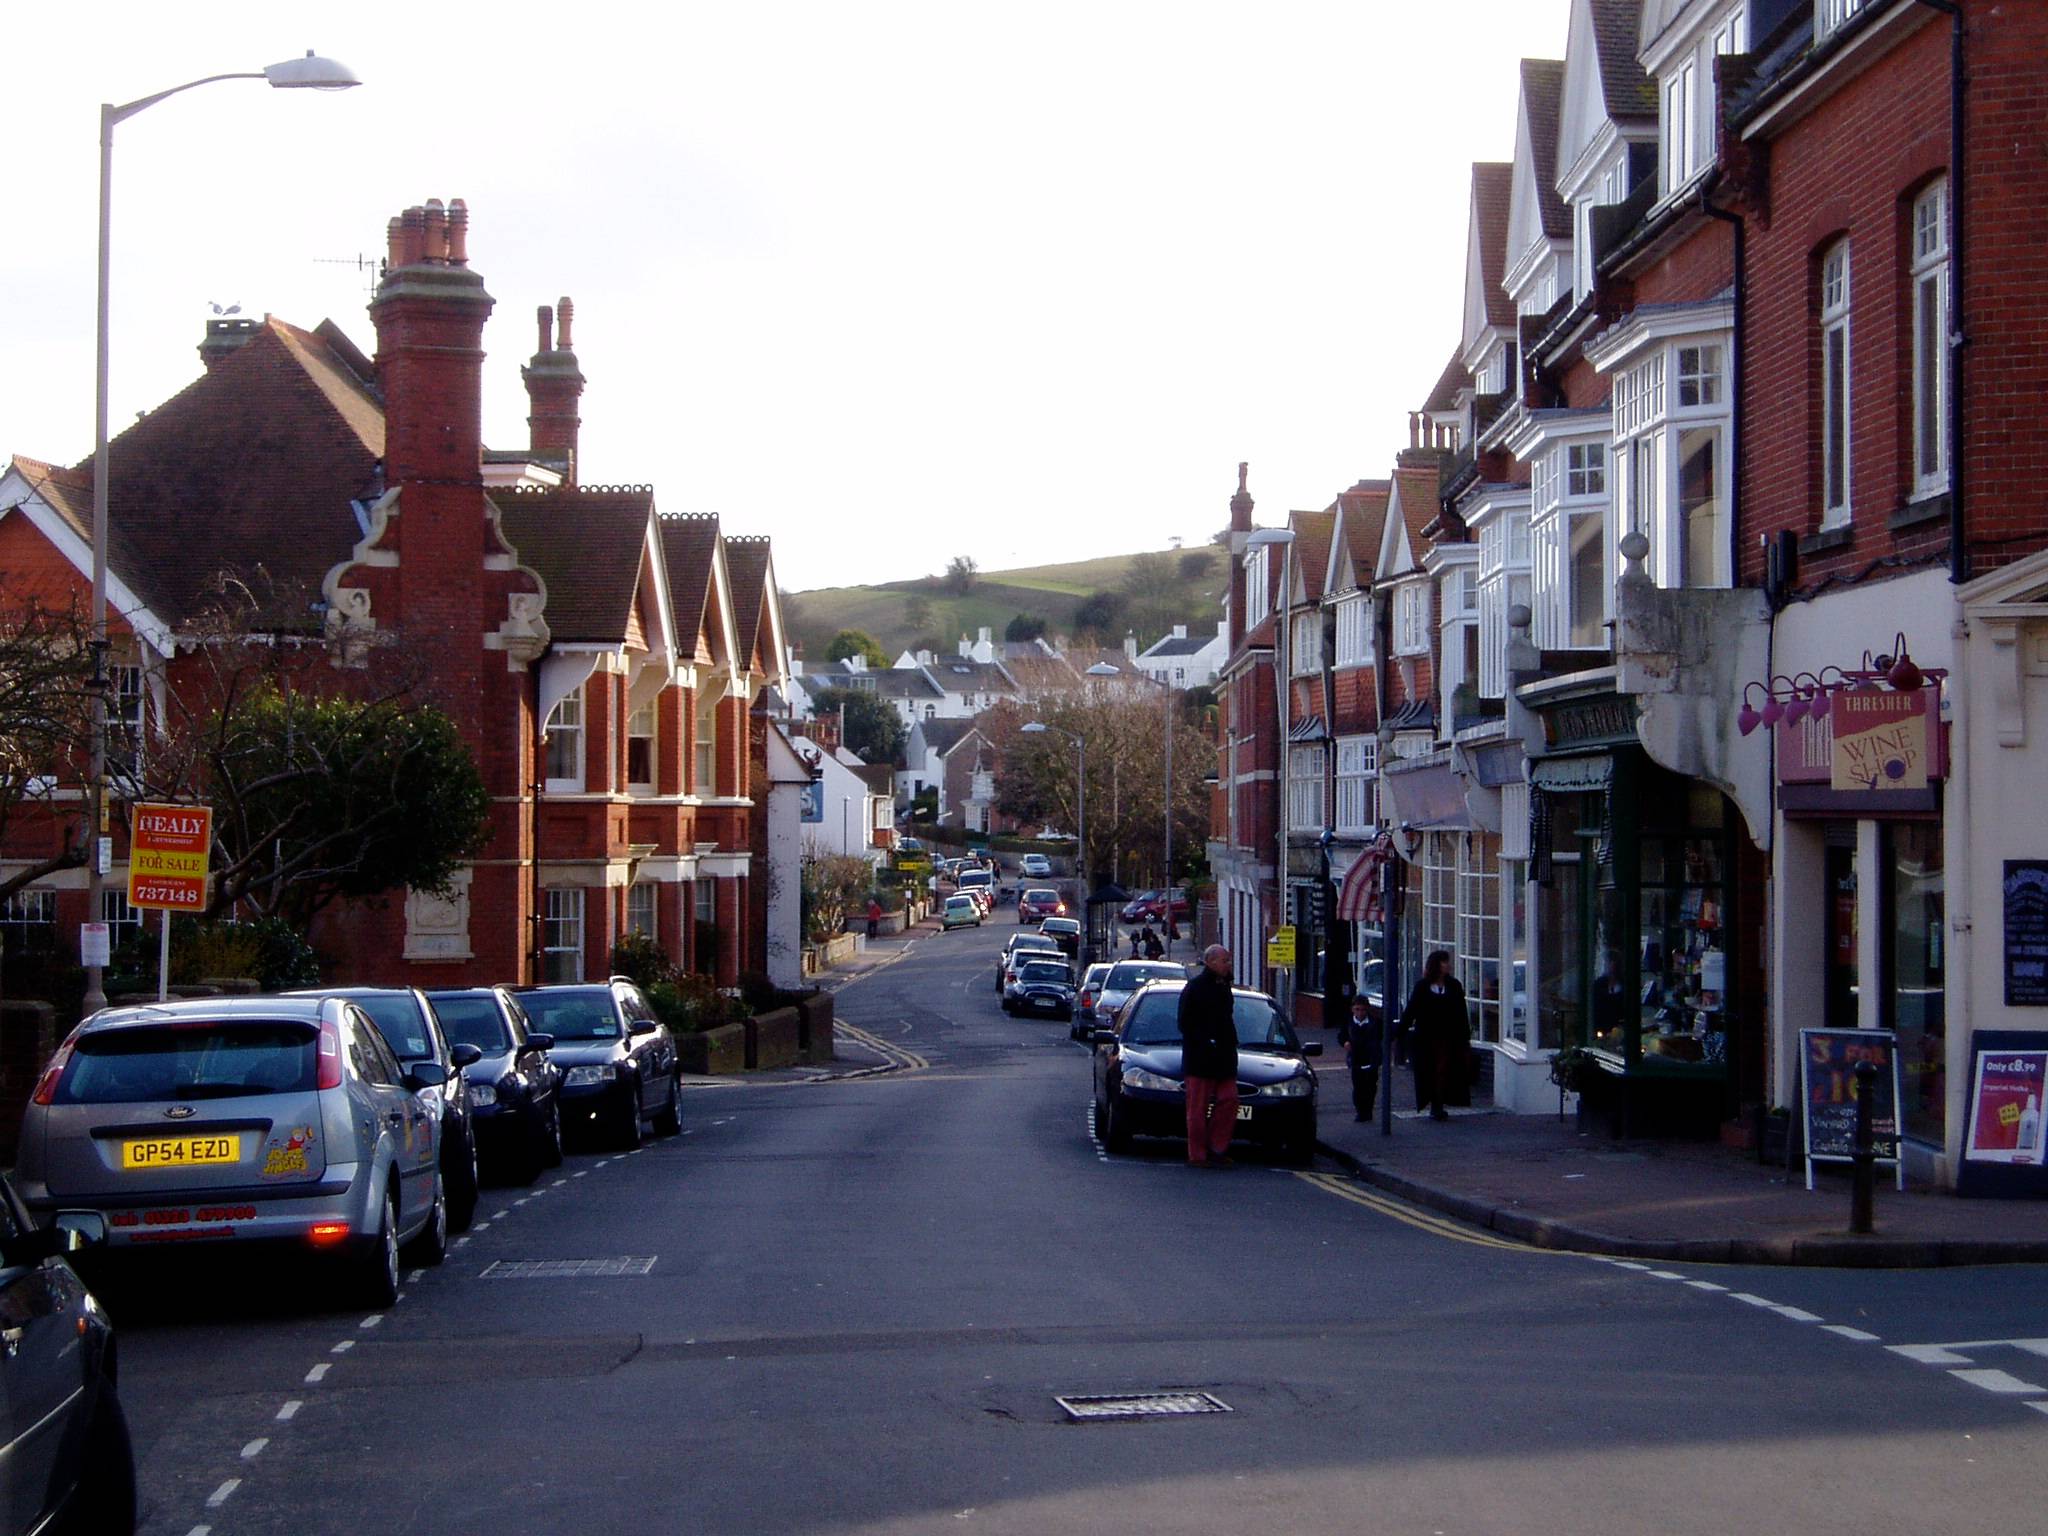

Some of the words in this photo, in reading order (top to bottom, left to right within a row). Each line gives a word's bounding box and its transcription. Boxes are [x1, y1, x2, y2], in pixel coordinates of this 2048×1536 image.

[1845, 695, 1912, 712] THRESHER
[1842, 726, 1913, 763] WINE
[1850, 750, 1917, 781] SHOP
[139, 856, 162, 869] FOR
[166, 858, 200, 872] SALE
[137, 886, 198, 903] 737148
[1986, 1062, 2005, 1073] Only
[2008, 1059, 2037, 1072] £8.99
[133, 1142, 184, 1162] GP54
[191, 1140, 230, 1159] EZD
